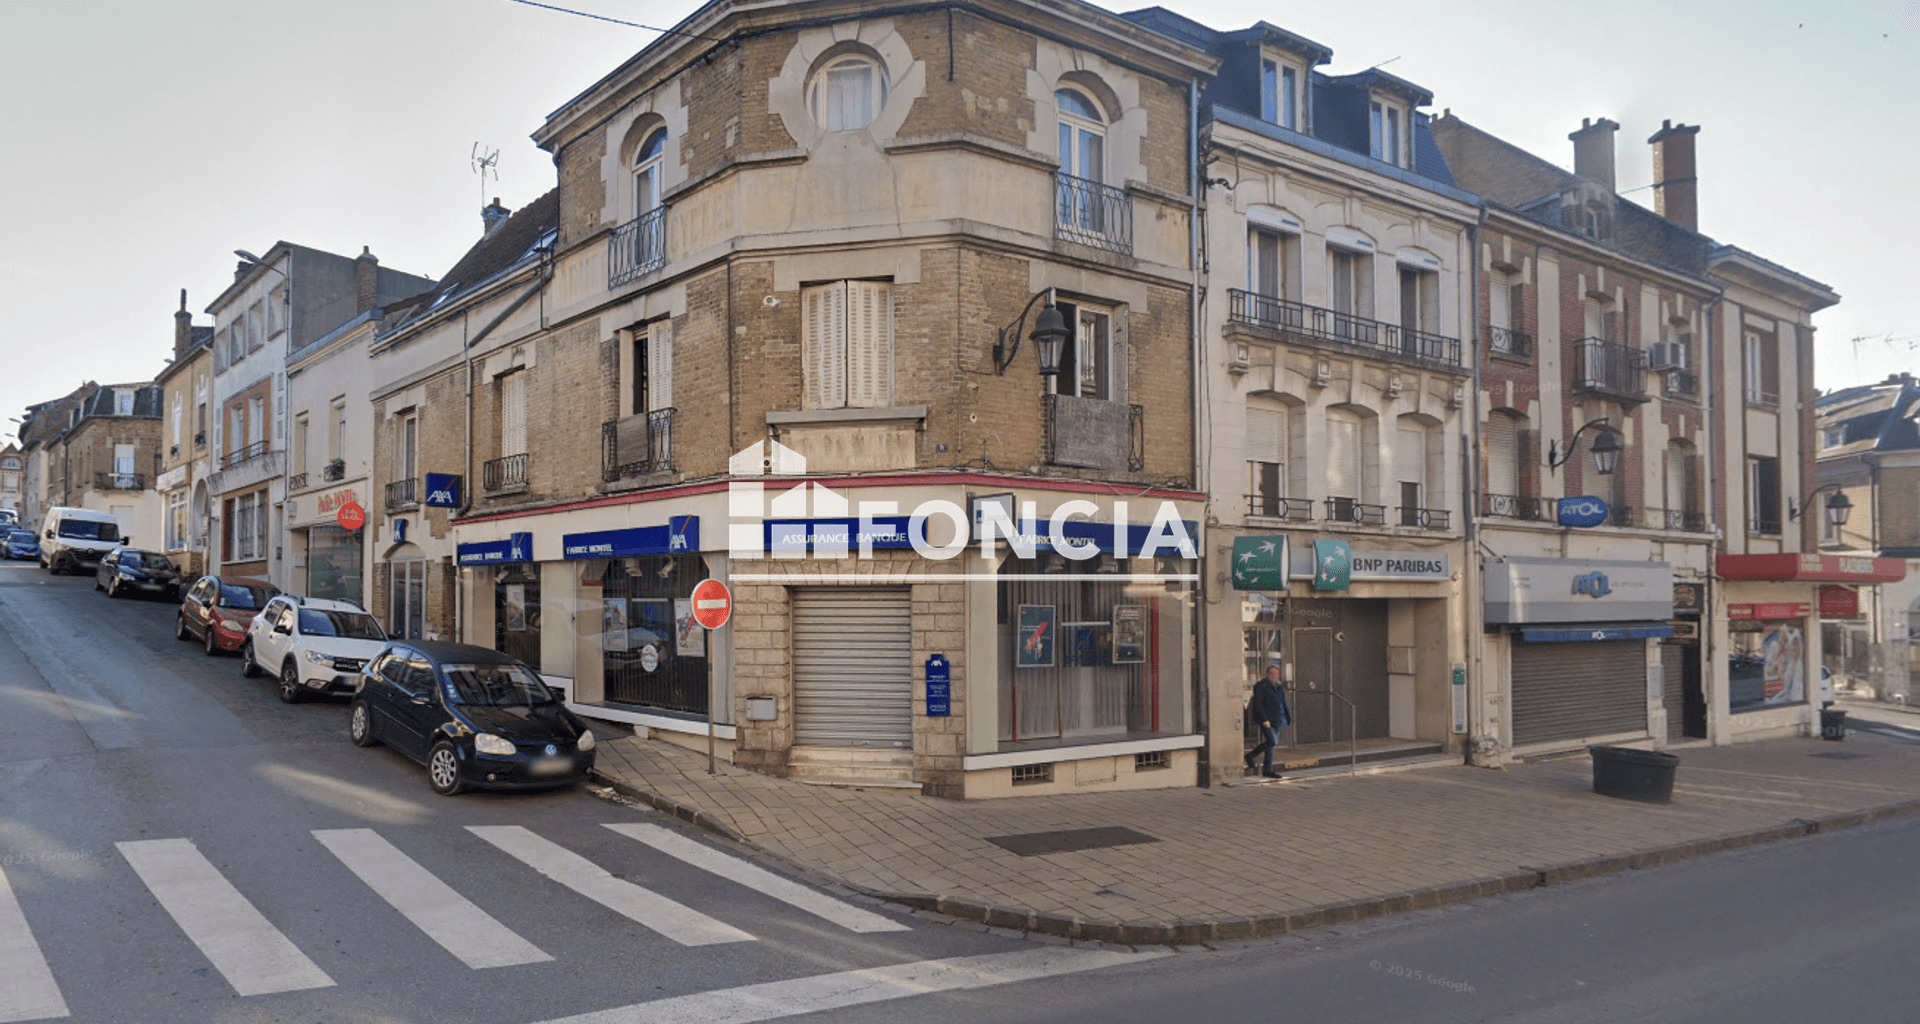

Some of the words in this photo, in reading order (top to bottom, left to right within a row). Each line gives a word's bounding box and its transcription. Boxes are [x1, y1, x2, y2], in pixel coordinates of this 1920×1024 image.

[427, 490, 453, 503] AXA
[1560, 502, 1604, 516] ATOL
[782, 532, 850, 544] ASSURANCE
[856, 532, 906, 543] BANQUE
[1019, 534, 1057, 545] FABRICE
[566, 545, 588, 555] FABRICE
[1353, 558, 1382, 571] BNP
[1386, 559, 1442, 573] PARIBAS
